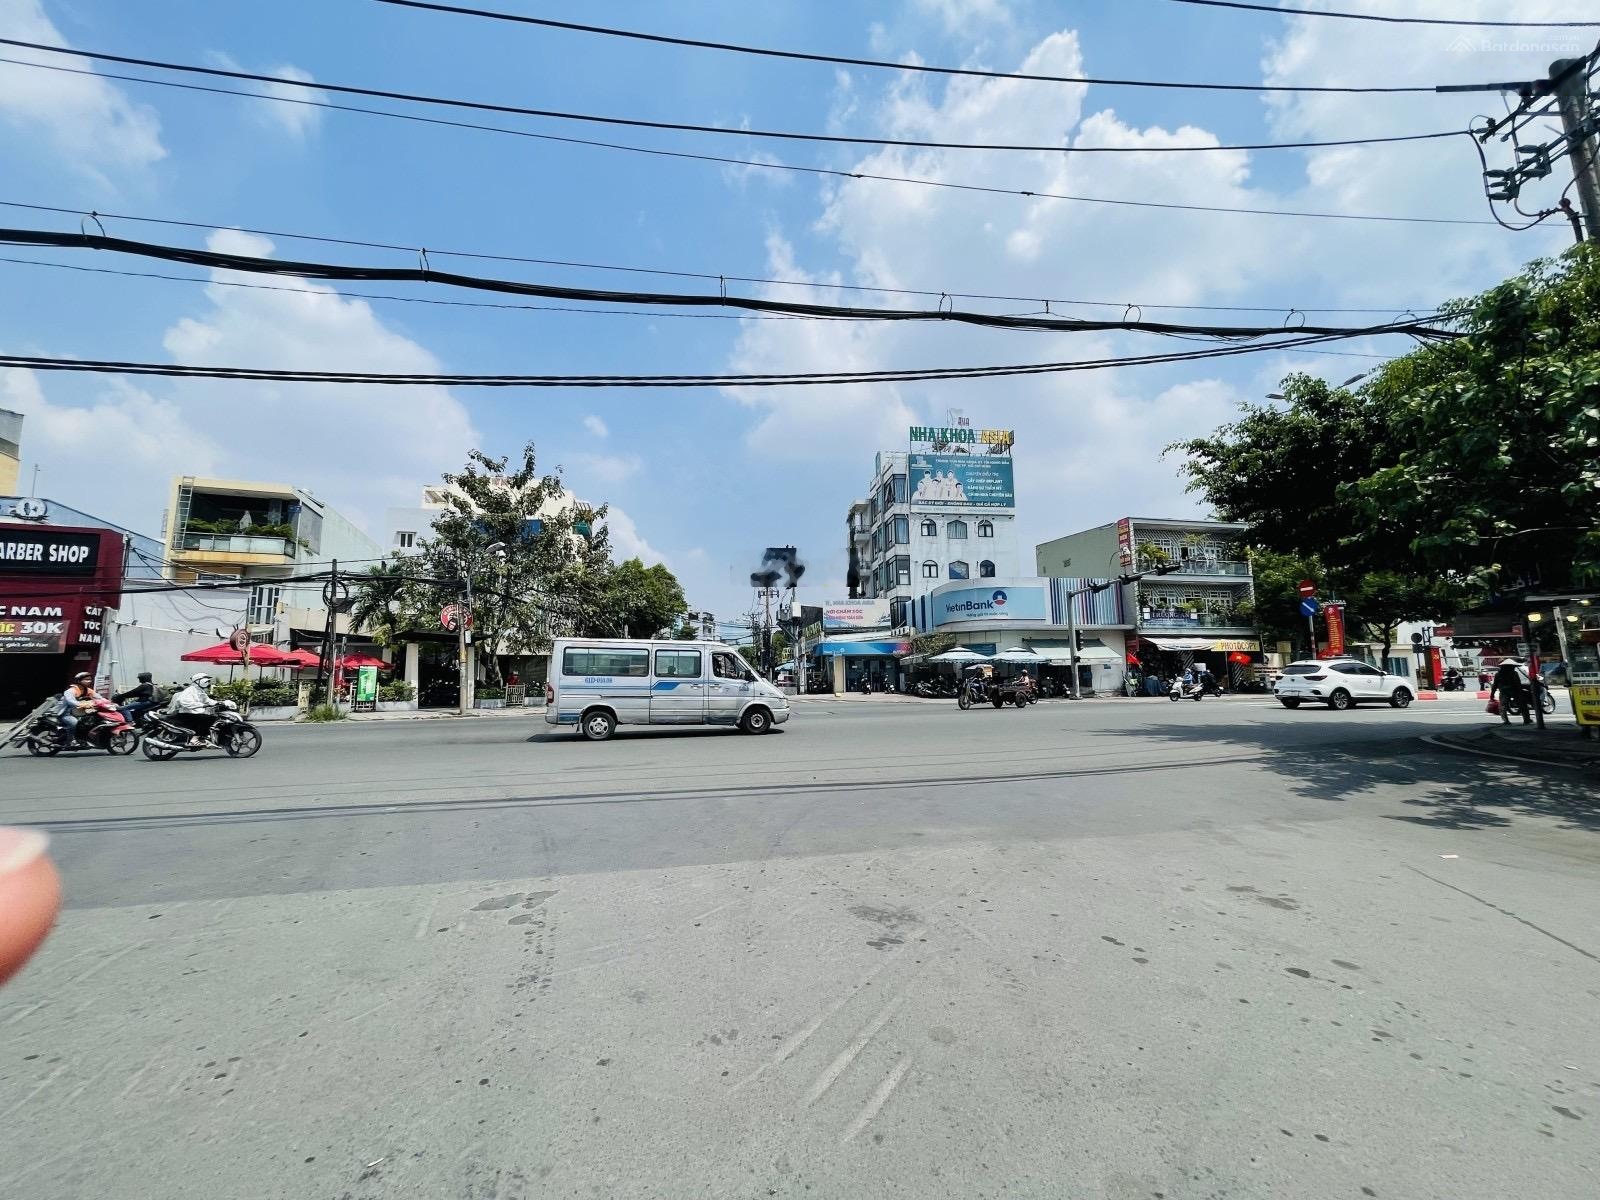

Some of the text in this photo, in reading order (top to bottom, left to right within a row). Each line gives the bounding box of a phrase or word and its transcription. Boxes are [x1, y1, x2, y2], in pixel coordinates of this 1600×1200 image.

[910, 426, 936, 441] NHA
[941, 427, 975, 443] KHOA
[49, 544, 90, 563] SHOP
[11, 606, 63, 617] NAM
[945, 599, 994, 613] VietinBank
[20, 621, 64, 634] 30K
[79, 633, 101, 644] NAM
[1220, 642, 1257, 650] PHOTOCOPY
